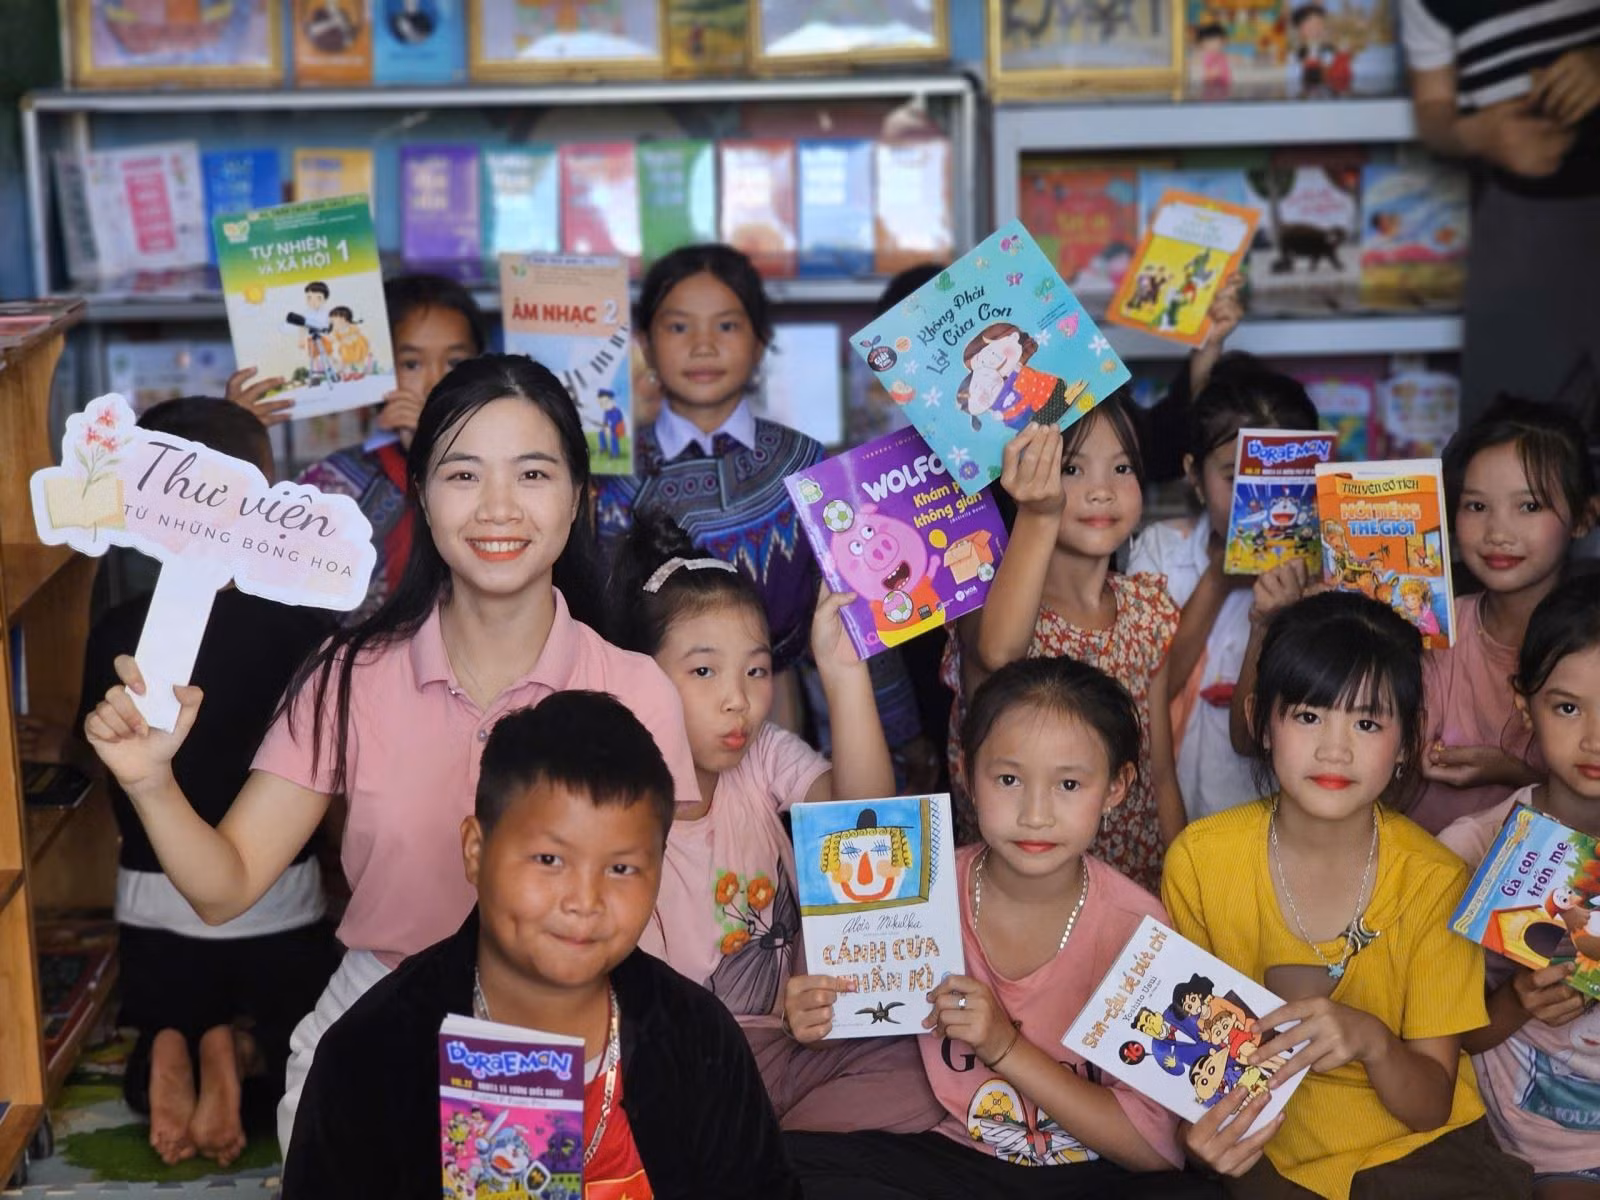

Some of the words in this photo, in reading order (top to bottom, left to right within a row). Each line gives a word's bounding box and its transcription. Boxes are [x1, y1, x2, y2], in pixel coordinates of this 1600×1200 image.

[276, 234, 329, 256] NHIÊN
[336, 238, 351, 263] 1
[542, 303, 597, 328] NHẠC
[603, 298, 618, 324] 2
[977, 302, 1012, 321] Con
[137, 441, 229, 508] Thư
[239, 490, 336, 540] viện
[861, 452, 947, 502] WOLFO
[913, 484, 951, 509] Khám
[913, 503, 954, 529] không
[955, 492, 983, 513] gian
[124, 503, 149, 520] TỪ
[158, 513, 232, 544] NHỮNG
[310, 556, 352, 577] HOA
[1501, 879, 1522, 897] Gà
[1518, 851, 1538, 875] con
[822, 936, 887, 966] CÁNH
[837, 964, 902, 997] HẦN
[1122, 993, 1145, 1022] Yoshito
[1141, 976, 1157, 996] Usui
